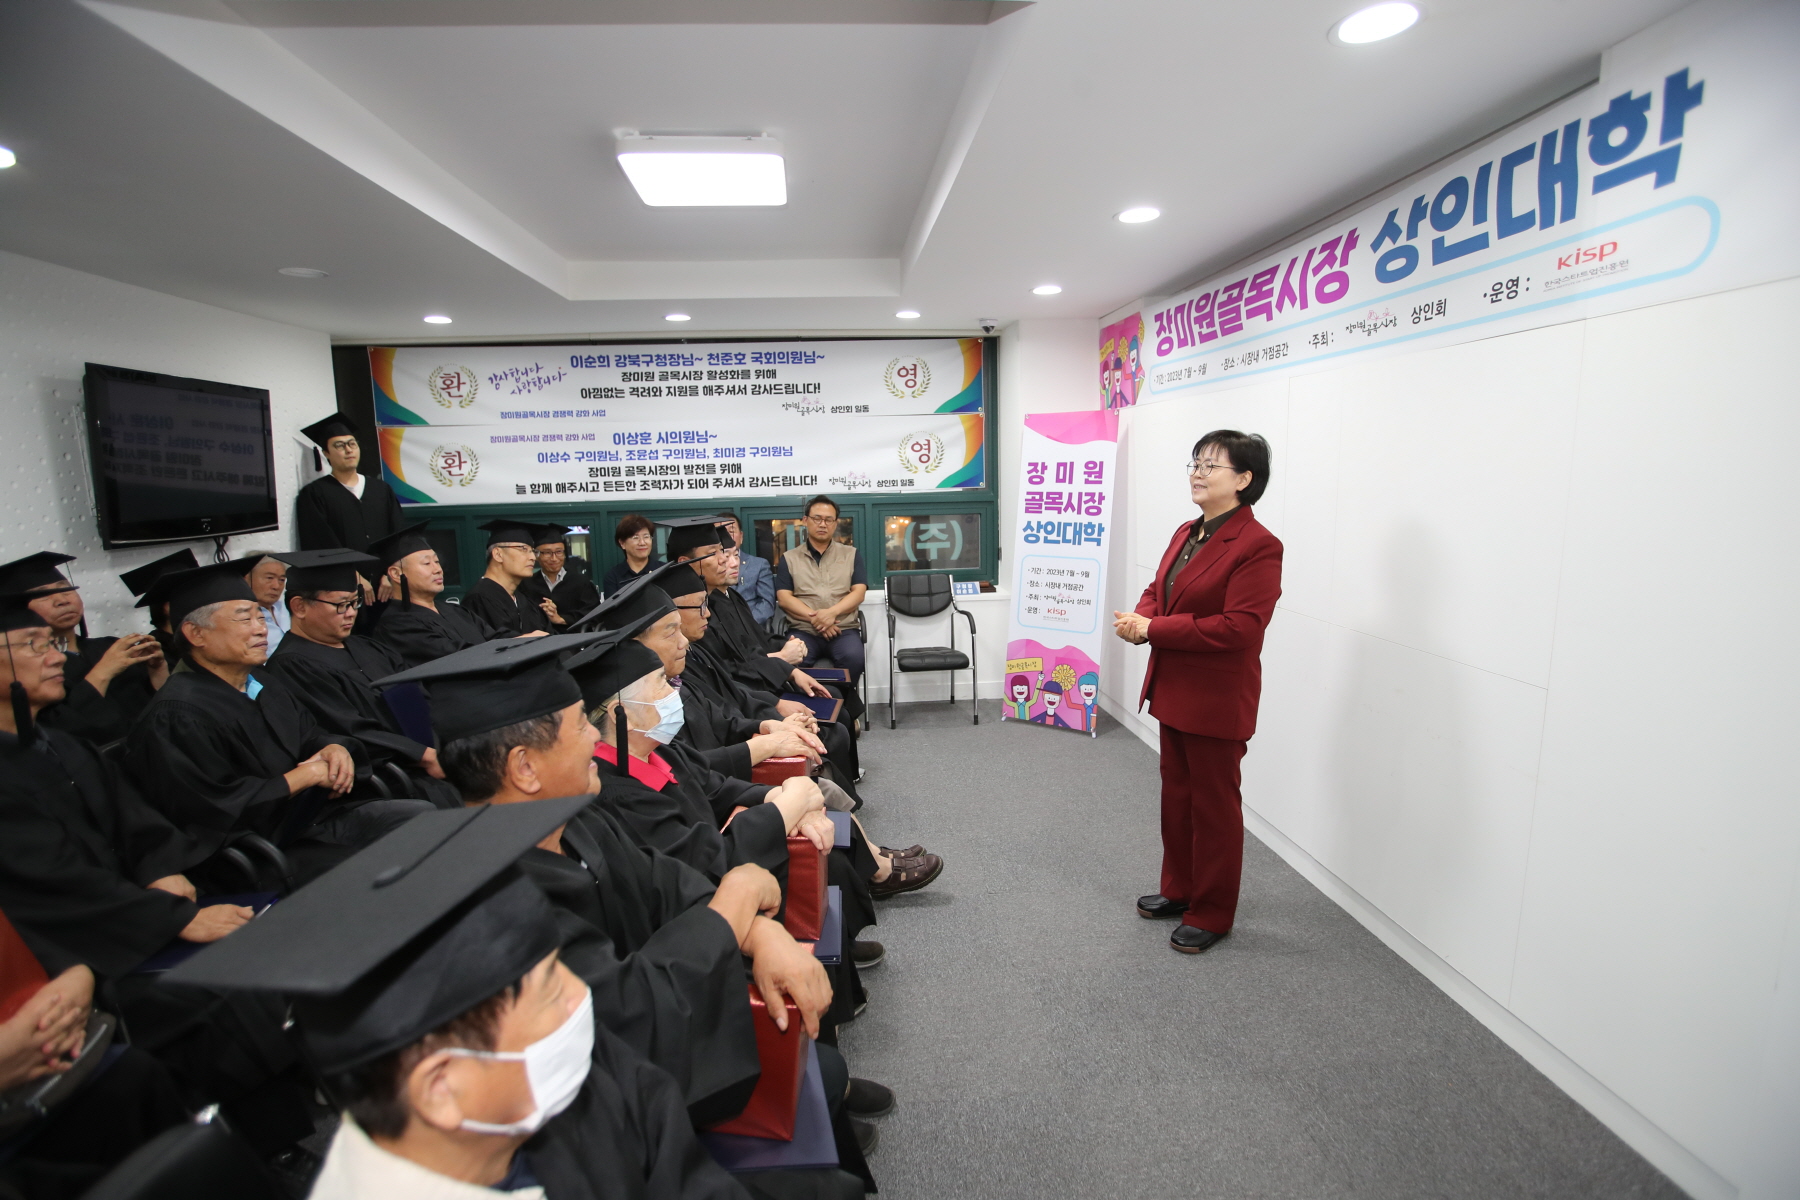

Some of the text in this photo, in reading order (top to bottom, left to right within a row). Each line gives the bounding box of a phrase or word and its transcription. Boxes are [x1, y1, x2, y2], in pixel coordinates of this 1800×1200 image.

[1154, 66, 1706, 357] 장미원골목시장 상인대학
[1410, 298, 1447, 325] 상인회
[570, 351, 825, 369] 이순희 강북구청장님~ 천준호 국회의원님~
[1240, 350, 1260, 366] 시장내
[1261, 342, 1289, 361] 거점공간
[621, 368, 777, 382] 장미원 골목시장 활성화를 위해
[897, 363, 918, 389] 영
[1167, 369, 1183, 382] 2023년
[1184, 366, 1192, 378] 7월
[1198, 363, 1208, 376] 9월
[439, 371, 466, 398] 환
[580, 382, 821, 399] 아낌없는 격려와 지원을 해주셔서 감사드립니다!
[500, 409, 606, 419] 장미원골목시장 경쟁력 강화 사업
[830, 405, 853, 414] 상인회
[854, 404, 870, 413] 일동
[490, 433, 596, 444] 장미원골목시장 경쟁력 강화 사업
[612, 430, 717, 445] 이상훈 시의원님~
[537, 446, 793, 464] 이상수 구의원님, 조윤섭 구의원님, 최미경 구의원님
[911, 439, 931, 464] 영
[441, 450, 468, 477] 환
[588, 463, 742, 478] 장미원 골목시장의 발전을 위해
[515, 475, 818, 495] 늘 함께 해주시고 든든한 조력자가 되어 주셔서 감사드립니다!
[876, 479, 899, 488] 상인회
[900, 479, 915, 487] 일동
[1024, 491, 1106, 516] 골목시장
[1022, 520, 1105, 546] 상인대학
[1046, 568, 1065, 577] 2023년
[1045, 581, 1061, 590] 시장내
